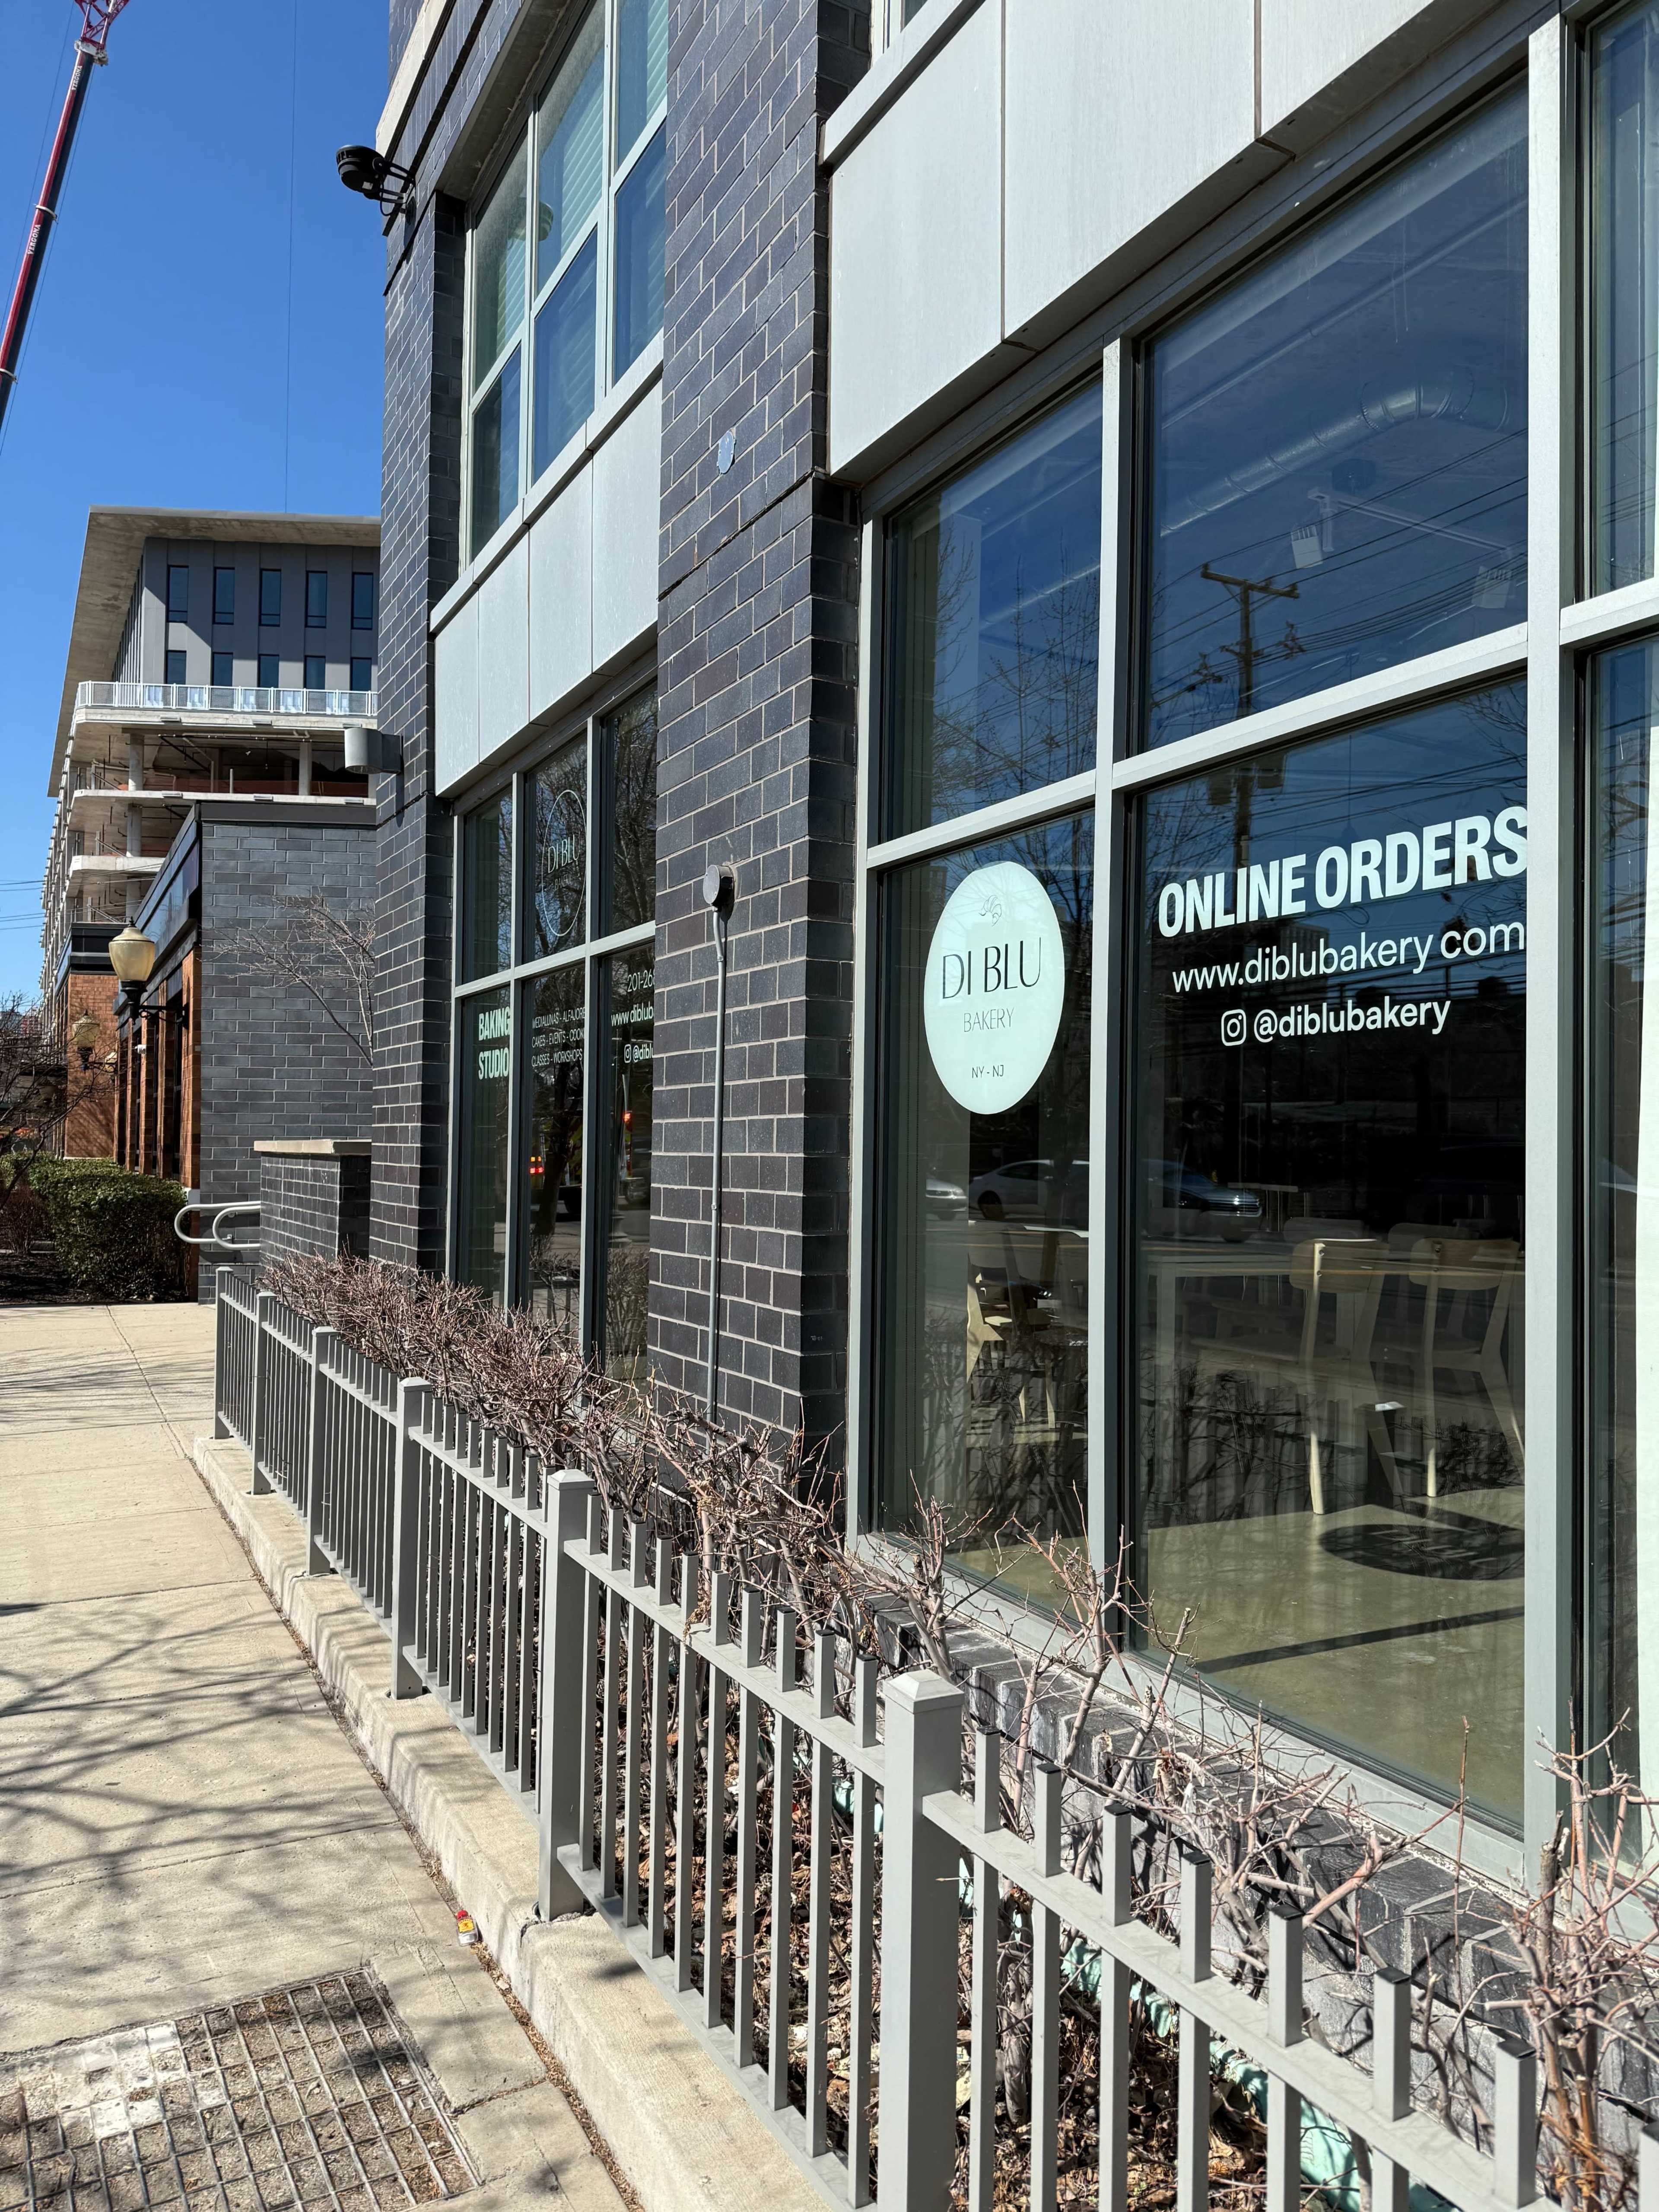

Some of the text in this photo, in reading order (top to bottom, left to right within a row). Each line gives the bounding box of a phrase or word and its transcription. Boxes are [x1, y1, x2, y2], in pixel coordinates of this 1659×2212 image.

[548, 832, 580, 873] DI BLU
[1159, 806, 1527, 937] ONLINE ORDERS
[627, 968, 655, 992] 201-26
[943, 937, 1041, 999] DI BLU
[478, 1006, 510, 1041] BAKING
[964, 1006, 1014, 1032] BAKERY
[1254, 996, 1451, 1043] @diblubakery
[532, 1034, 546, 1048] CAKES
[549, 1031, 566, 1045] EVENTS
[478, 1047, 509, 1080] STUDIO
[531, 1053, 550, 1067] CLASSES
[553, 1048, 583, 1064] WORKSHOPS
[972, 1066, 985, 1078] NY
[992, 1064, 1004, 1077] NJ
